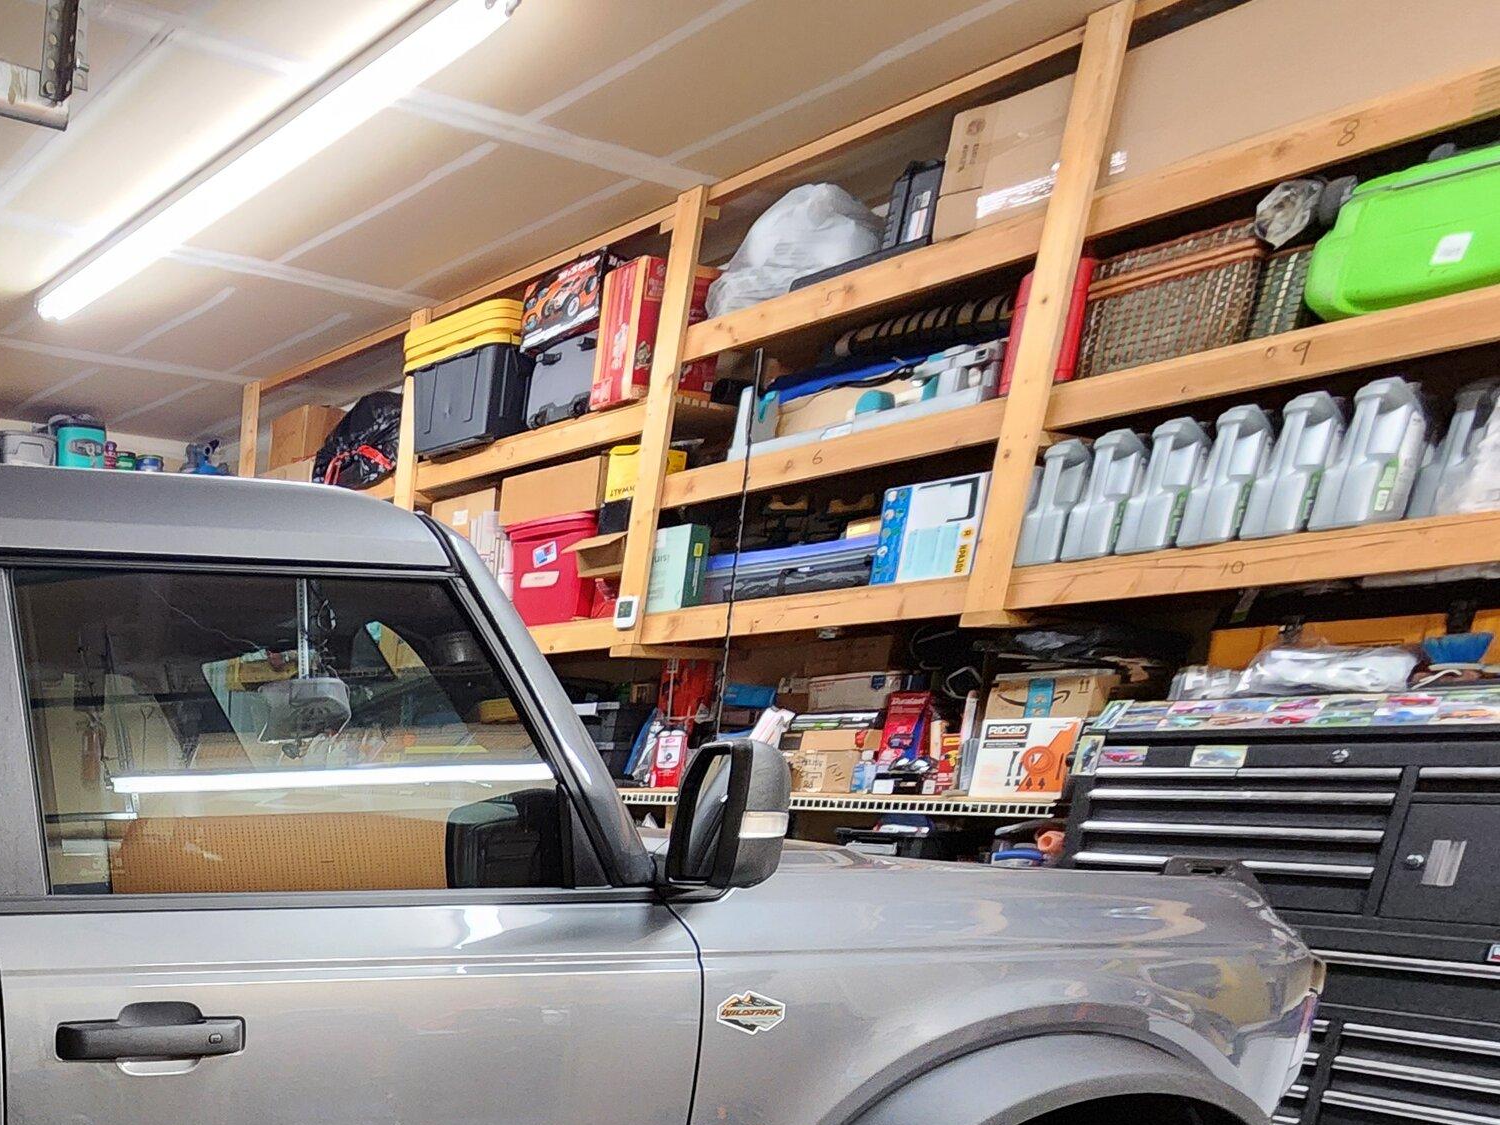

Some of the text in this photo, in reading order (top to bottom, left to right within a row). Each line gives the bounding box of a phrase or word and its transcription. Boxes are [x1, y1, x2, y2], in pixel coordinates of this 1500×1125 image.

[1337, 118, 1360, 147] 8
[1292, 340, 1312, 366] 9
[811, 448, 824, 465] 6
[987, 725, 1028, 735] RIDGID
